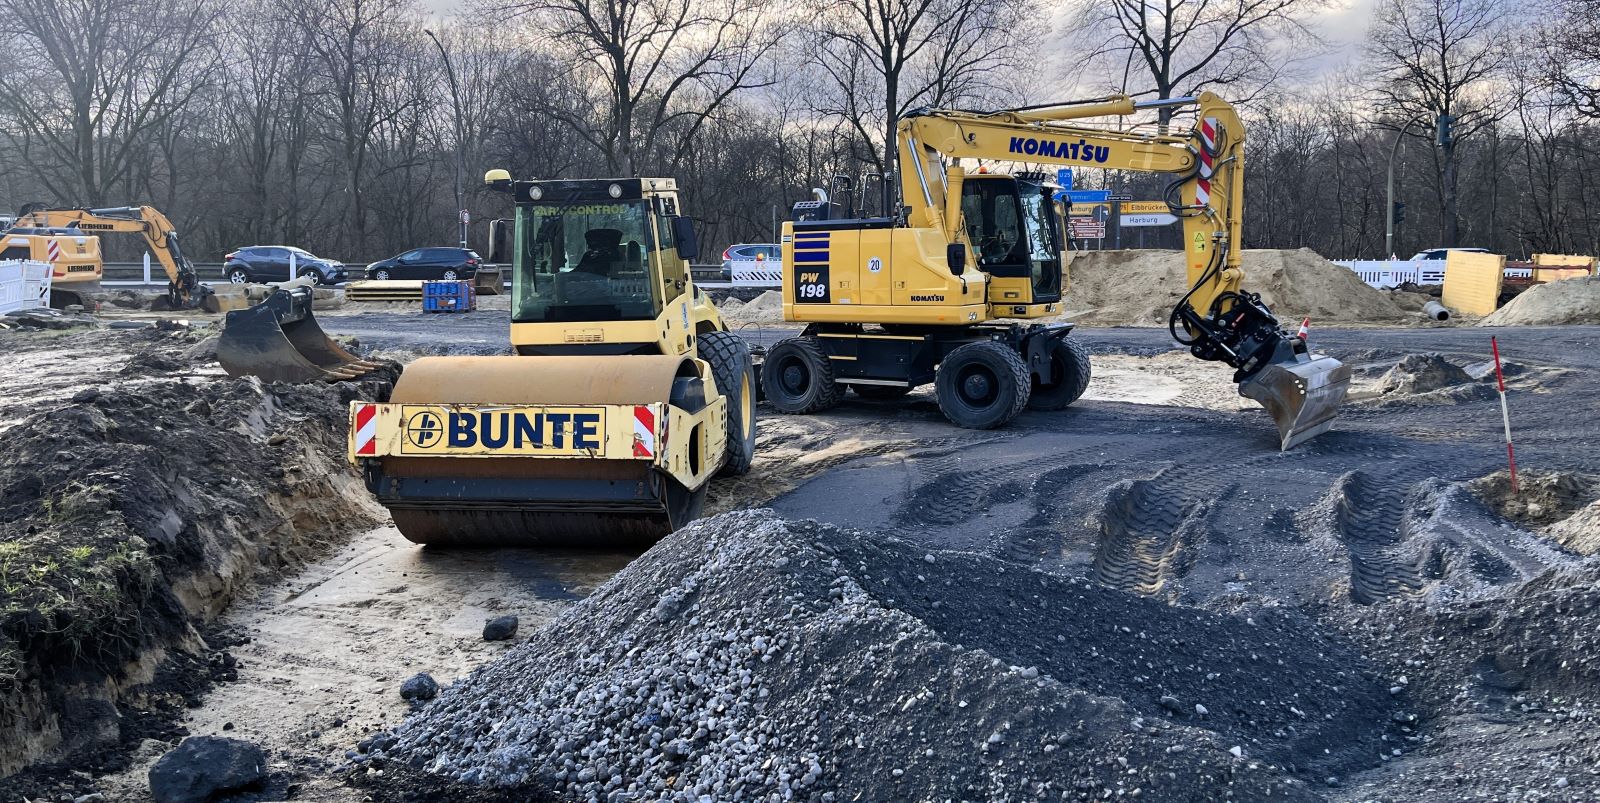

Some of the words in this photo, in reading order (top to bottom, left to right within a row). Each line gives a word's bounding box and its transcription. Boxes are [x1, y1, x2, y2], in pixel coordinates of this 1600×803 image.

[1009, 136, 1110, 163] KOMATSU
[1131, 203, 1167, 211] Elbbrücken
[870, 259, 880, 271] 20
[800, 272, 819, 282] PW
[799, 284, 825, 298] 198
[911, 294, 945, 302] KOMATSU
[448, 412, 600, 449] BUNTE
